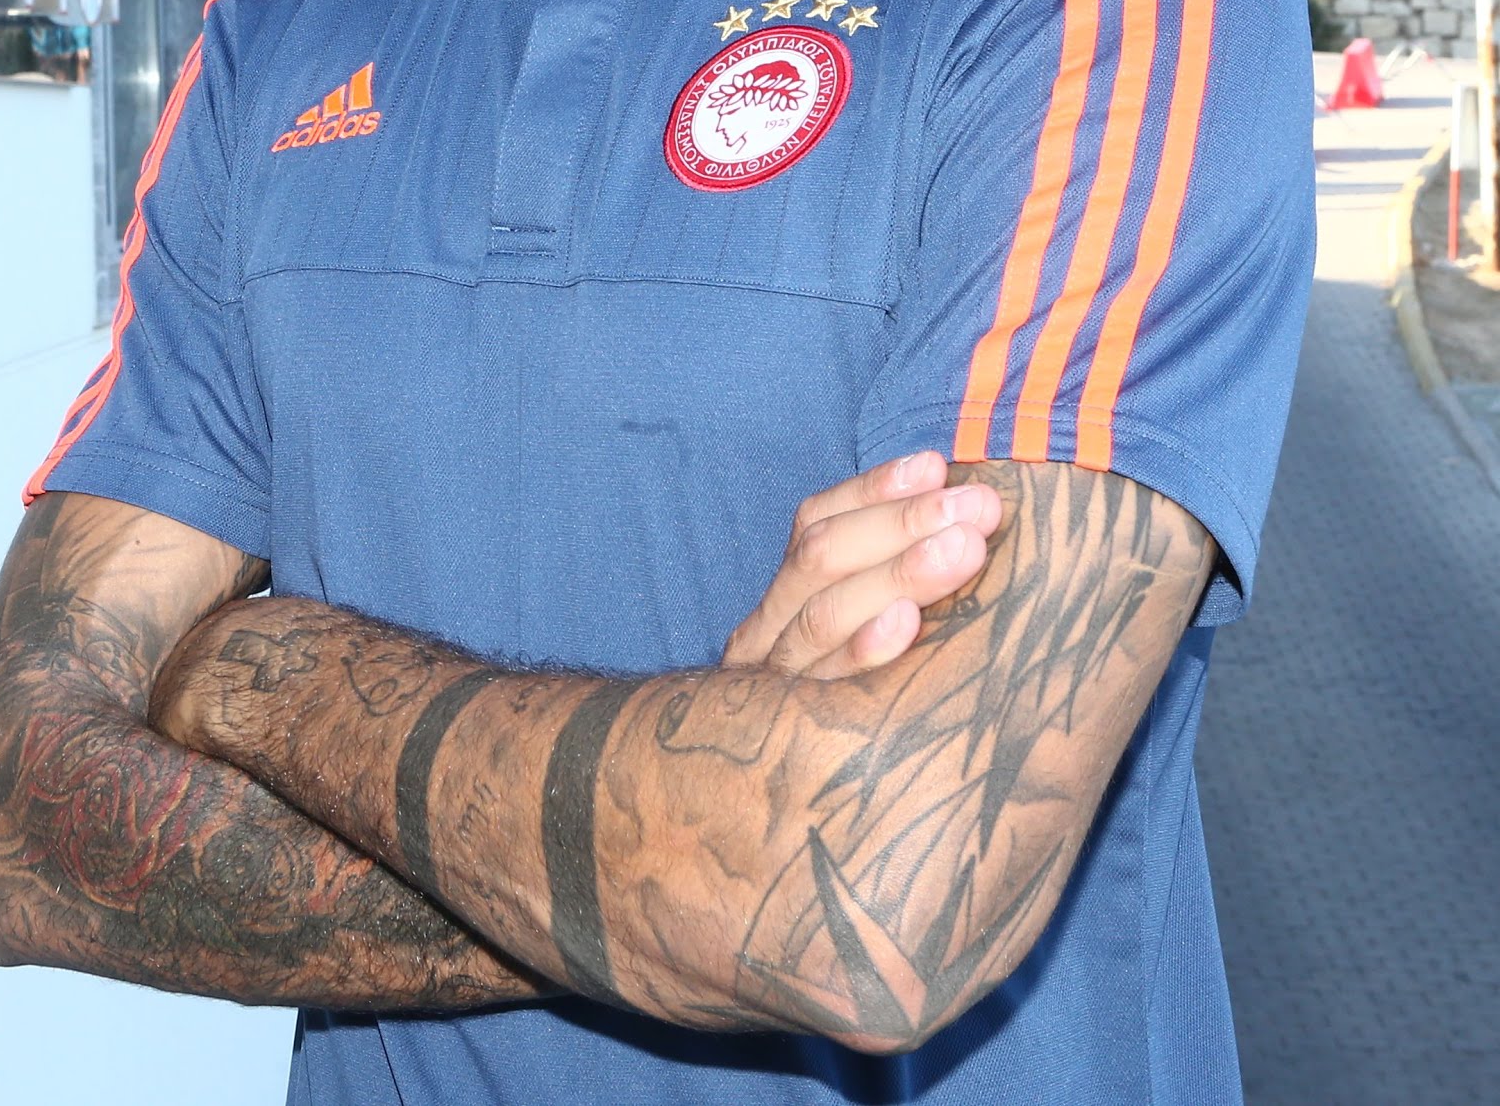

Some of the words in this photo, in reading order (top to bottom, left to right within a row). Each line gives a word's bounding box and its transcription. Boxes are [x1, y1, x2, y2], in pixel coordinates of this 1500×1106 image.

[713, 37, 822, 75] ΟΛΥΜΠΙΑΚΟΣ
[270, 111, 381, 153] adidas
[677, 78, 710, 169] ΣΥΝΔΕΣΜΟΣ
[764, 117, 791, 130] 1925
[704, 136, 800, 177] ΦΙΛΑΘΛΩΝ
